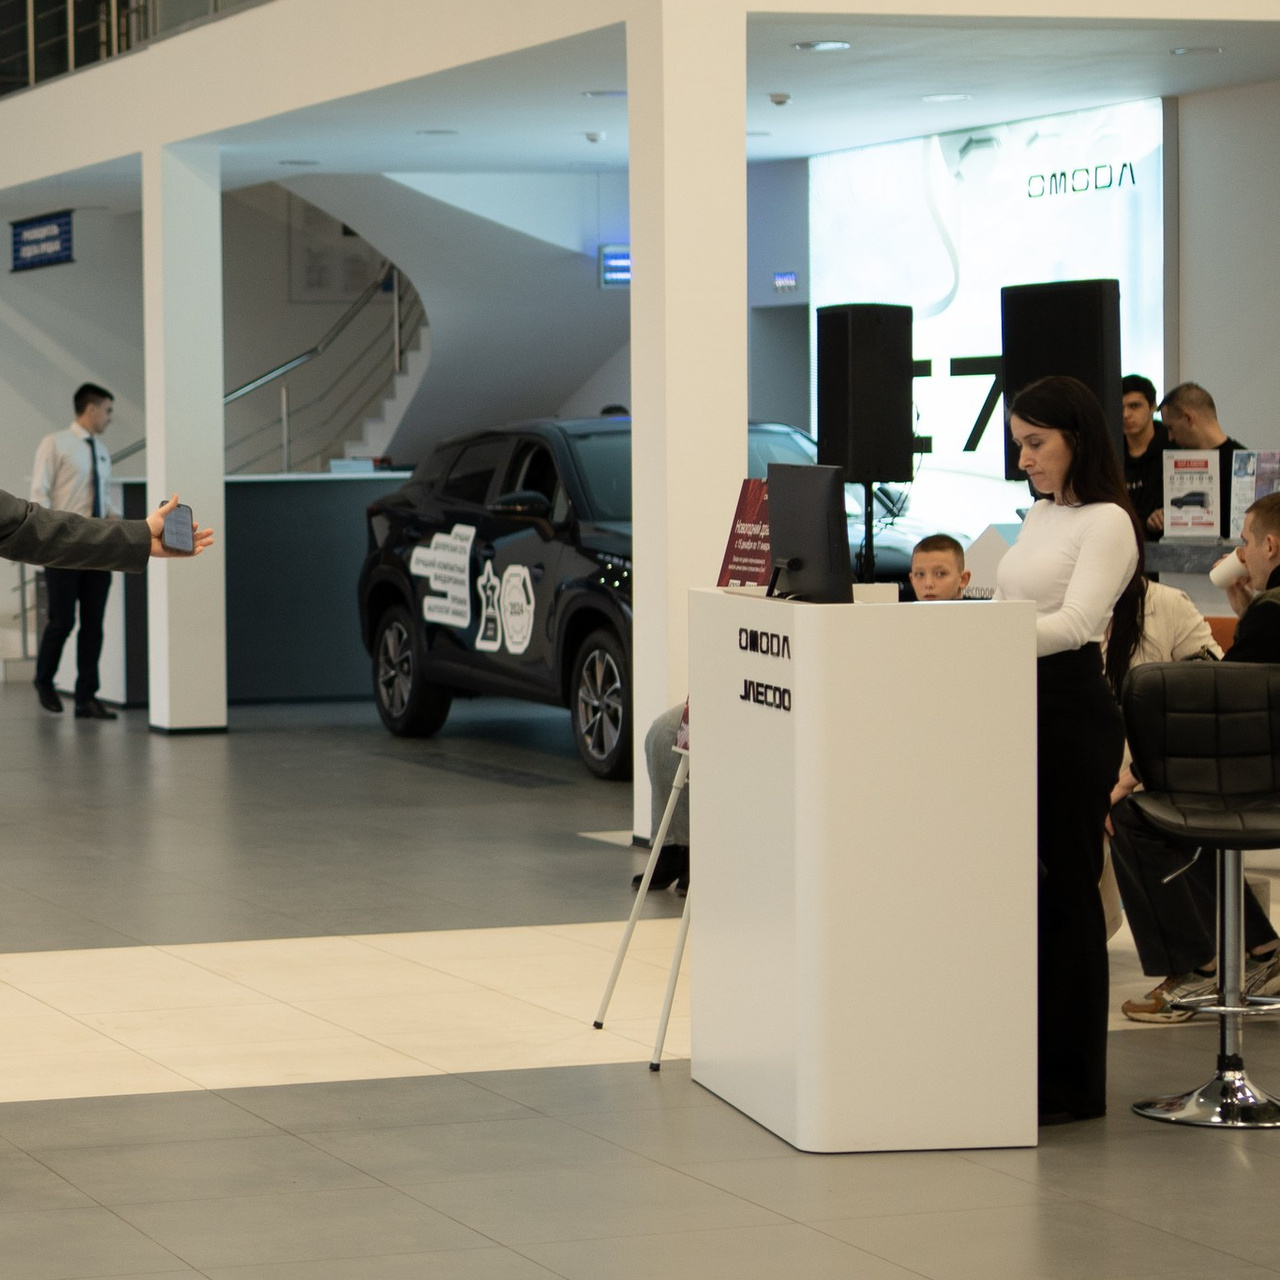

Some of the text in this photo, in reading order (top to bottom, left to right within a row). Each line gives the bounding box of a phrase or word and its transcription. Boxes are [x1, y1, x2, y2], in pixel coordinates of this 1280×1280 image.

[1028, 162, 1135, 198] OMODA
[759, 523, 770, 538] дра
[760, 543, 771, 552] январ
[510, 602, 524, 616] 2024
[739, 627, 791, 660] OMODA
[739, 679, 791, 712] JAECOO
